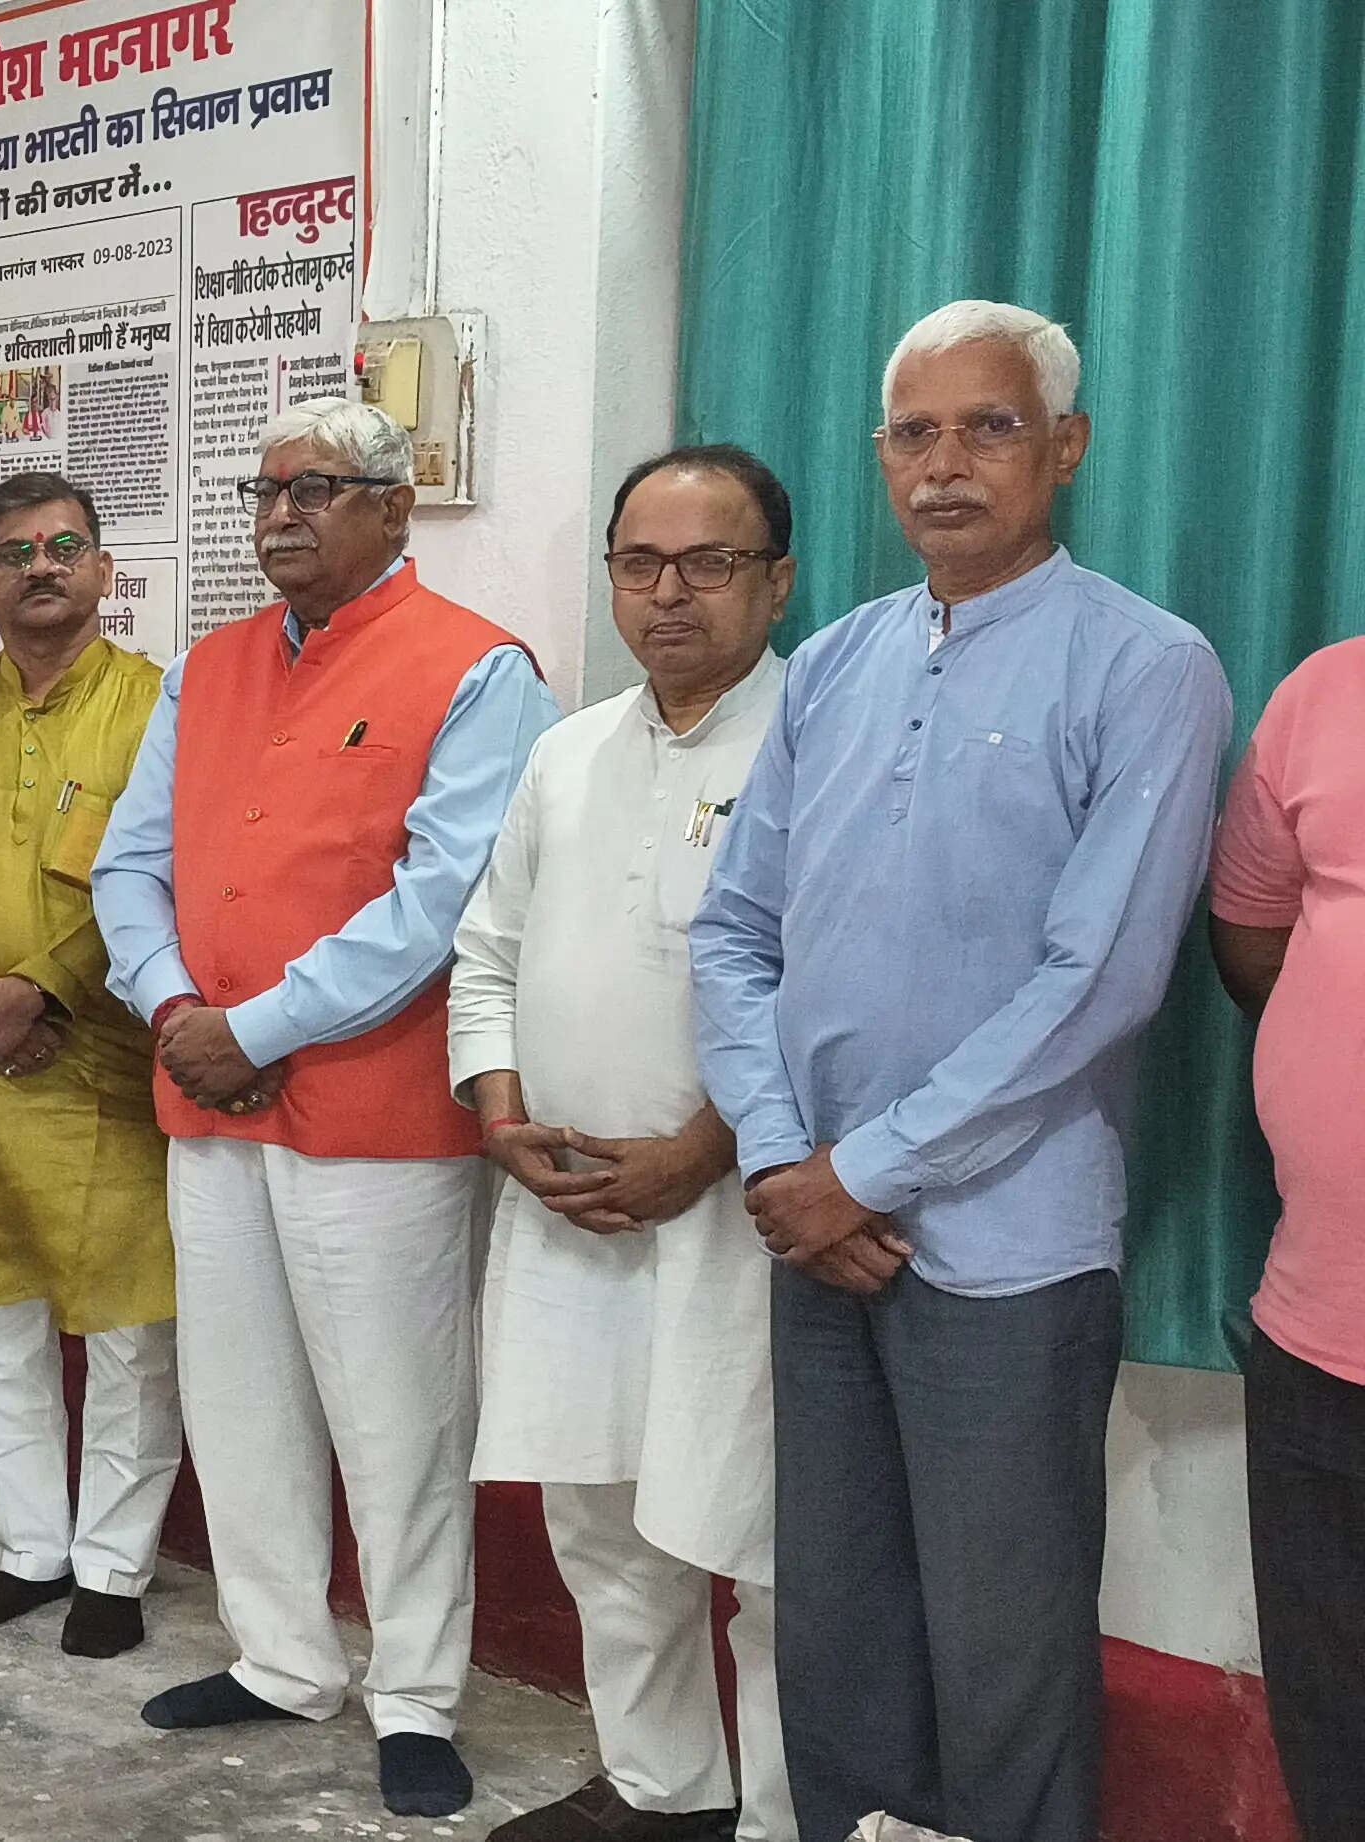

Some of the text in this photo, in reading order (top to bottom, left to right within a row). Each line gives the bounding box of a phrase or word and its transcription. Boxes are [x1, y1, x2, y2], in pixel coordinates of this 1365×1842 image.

[58, 0, 236, 88] भटनागर
[25, 103, 99, 166] भारती
[106, 107, 144, 149] का
[150, 86, 242, 140] सिवान
[248, 68, 332, 131] प्रवास
[15, 184, 48, 217] की
[53, 172, 115, 210] नजर
[41, 251, 85, 274] भास्कर
[93, 237, 173, 265] 09-08-2023
[226, 258, 252, 295] नीति
[281, 250, 293, 288] से
[294, 256, 324, 293] लागू
[4, 329, 75, 362] शक्तिशाली
[78, 326, 112, 353] प्राणी
[114, 322, 129, 350] हैं
[129, 321, 172, 351] मनुष्य
[194, 298, 322, 348] में विद्या करेगी सहयोग
[115, 572, 147, 600] विद्या
